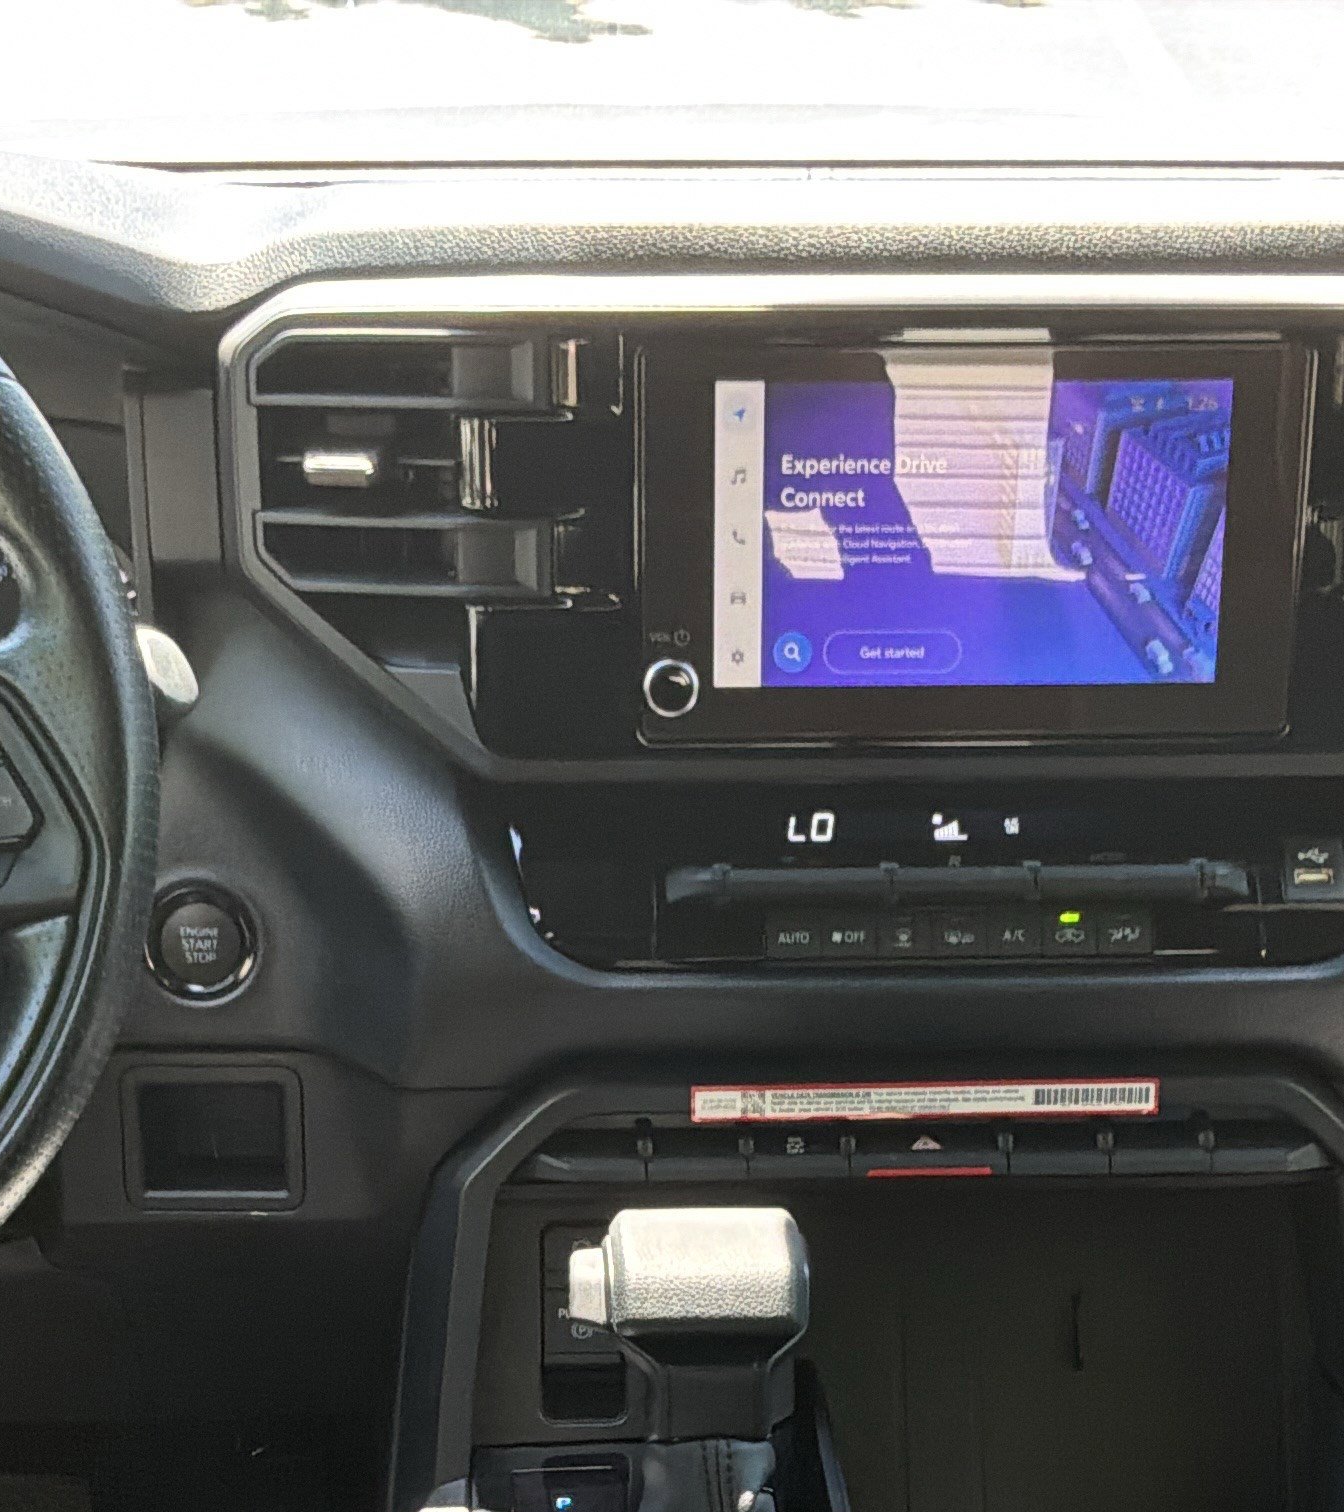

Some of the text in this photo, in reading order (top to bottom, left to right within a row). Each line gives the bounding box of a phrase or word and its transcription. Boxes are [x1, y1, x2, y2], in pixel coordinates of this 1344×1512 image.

[781, 453, 948, 479] Experience Drive
[780, 486, 866, 508] Connect
[843, 540, 869, 550] Cloud
[860, 645, 925, 659] Get started
[787, 810, 835, 843] LO
[179, 926, 218, 937] ENGINE
[778, 931, 810, 945] AUTO
[844, 930, 865, 943] OFF
[1002, 929, 1025, 942] A/C
[181, 938, 217, 951] START
[185, 951, 216, 964] STOP
[556, 1497, 572, 1510] P
